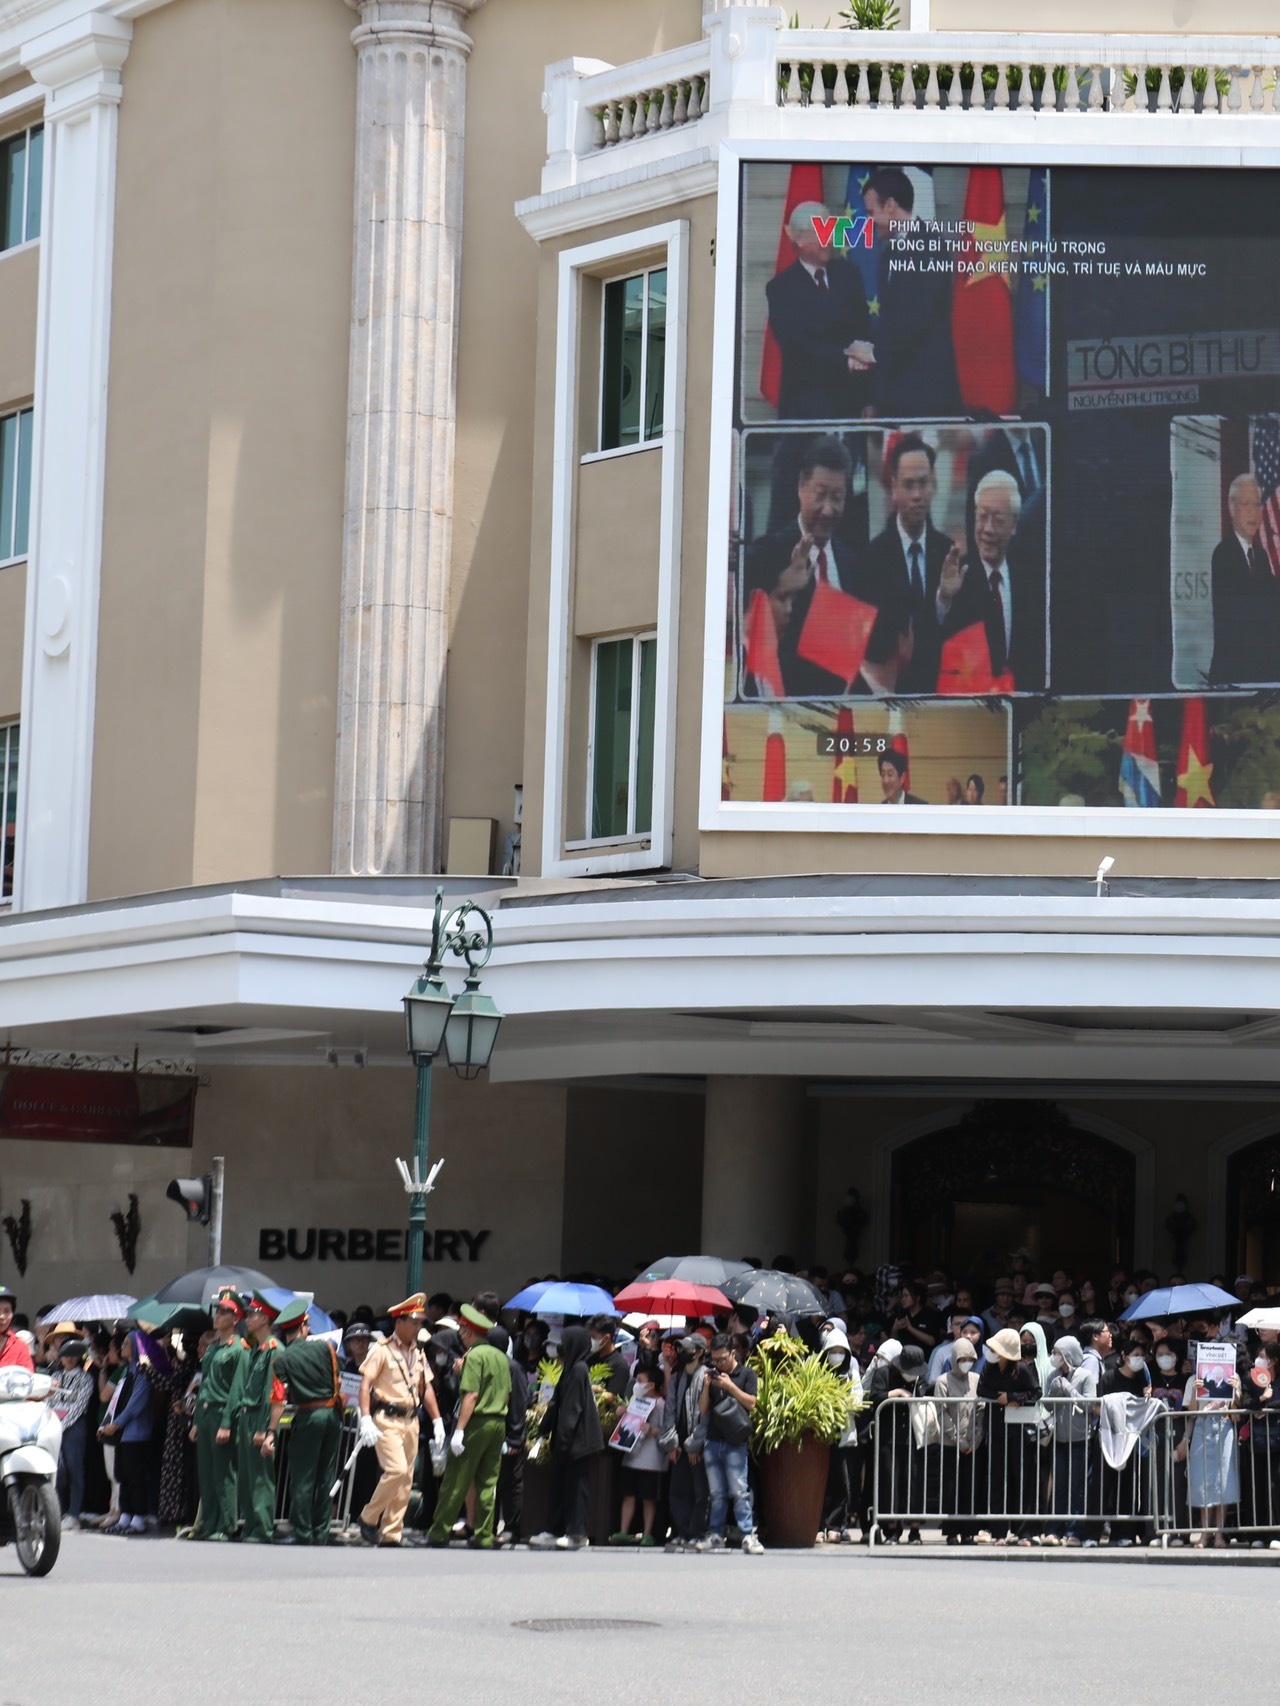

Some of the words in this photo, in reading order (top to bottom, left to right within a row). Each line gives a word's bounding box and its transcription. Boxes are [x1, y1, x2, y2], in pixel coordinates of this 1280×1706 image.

[811, 216, 873, 248] VTV1
[889, 220, 920, 232] PHIM
[947, 221, 975, 236] LIỆU
[945, 240, 972, 252] THƯ
[1062, 241, 1106, 256] TRỌNG
[957, 261, 985, 275] ĐẠO
[1022, 262, 1069, 276] TRUNG,
[1177, 263, 1206, 278] MỰC
[1169, 336, 1193, 375] BÍ
[1200, 336, 1266, 374] THƯ
[1175, 571, 1209, 600] CSIS
[826, 738, 886, 752] 20:58
